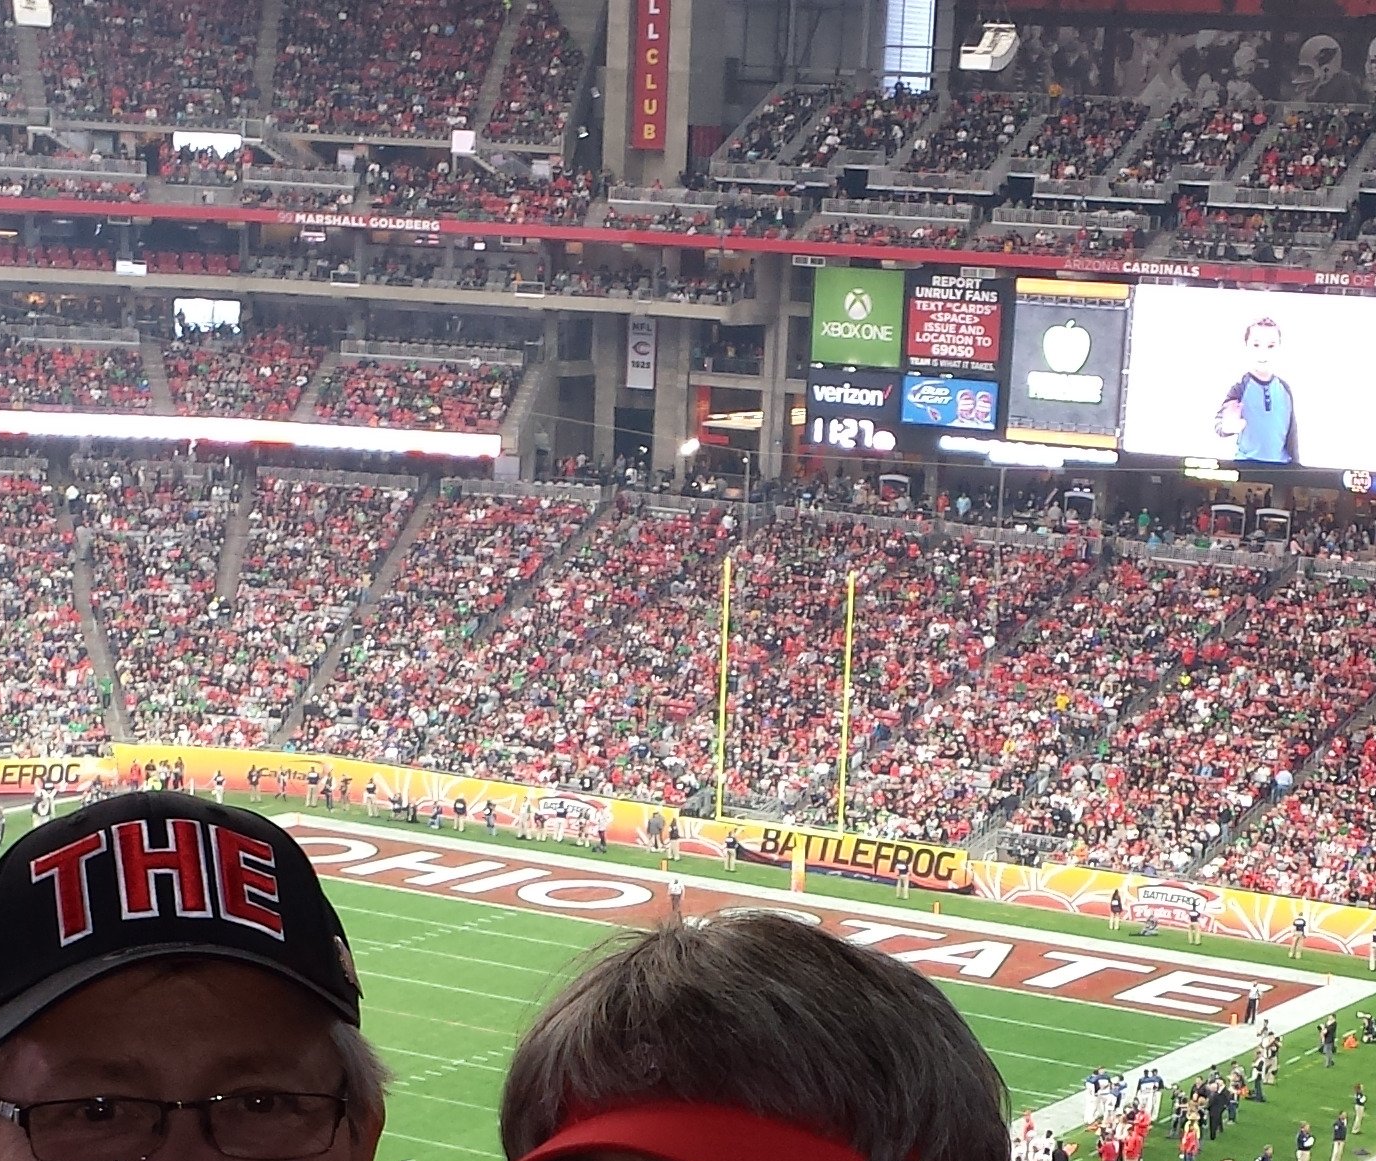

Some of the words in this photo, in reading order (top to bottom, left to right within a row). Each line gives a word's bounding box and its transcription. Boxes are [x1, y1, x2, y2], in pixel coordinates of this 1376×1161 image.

[644, 48, 660, 139] CLUB
[278, 213, 292, 223] 99
[295, 213, 367, 227] MARSHALL
[369, 217, 440, 231] GOLDBERG
[1064, 259, 1120, 272] ARIZONA
[1123, 262, 1200, 277] CARDINALS
[932, 275, 982, 289] REPORT
[1315, 273, 1350, 285] RING
[1353, 275, 1371, 286] OF
[915, 287, 963, 300] UNRULY
[965, 290, 998, 302] FANS
[914, 300, 944, 311] TEXT
[946, 302, 997, 315] "CARDS"
[929, 312, 980, 324] <SPACE>
[924, 321, 956, 334] ISSUE
[959, 324, 985, 335] AND
[915, 332, 973, 345] LOCATION
[975, 336, 992, 347] TO
[931, 343, 974, 358] 69050
[813, 383, 884, 407] verizon
[761, 828, 956, 881] BATTLEFROG
[30, 819, 285, 948] THE
